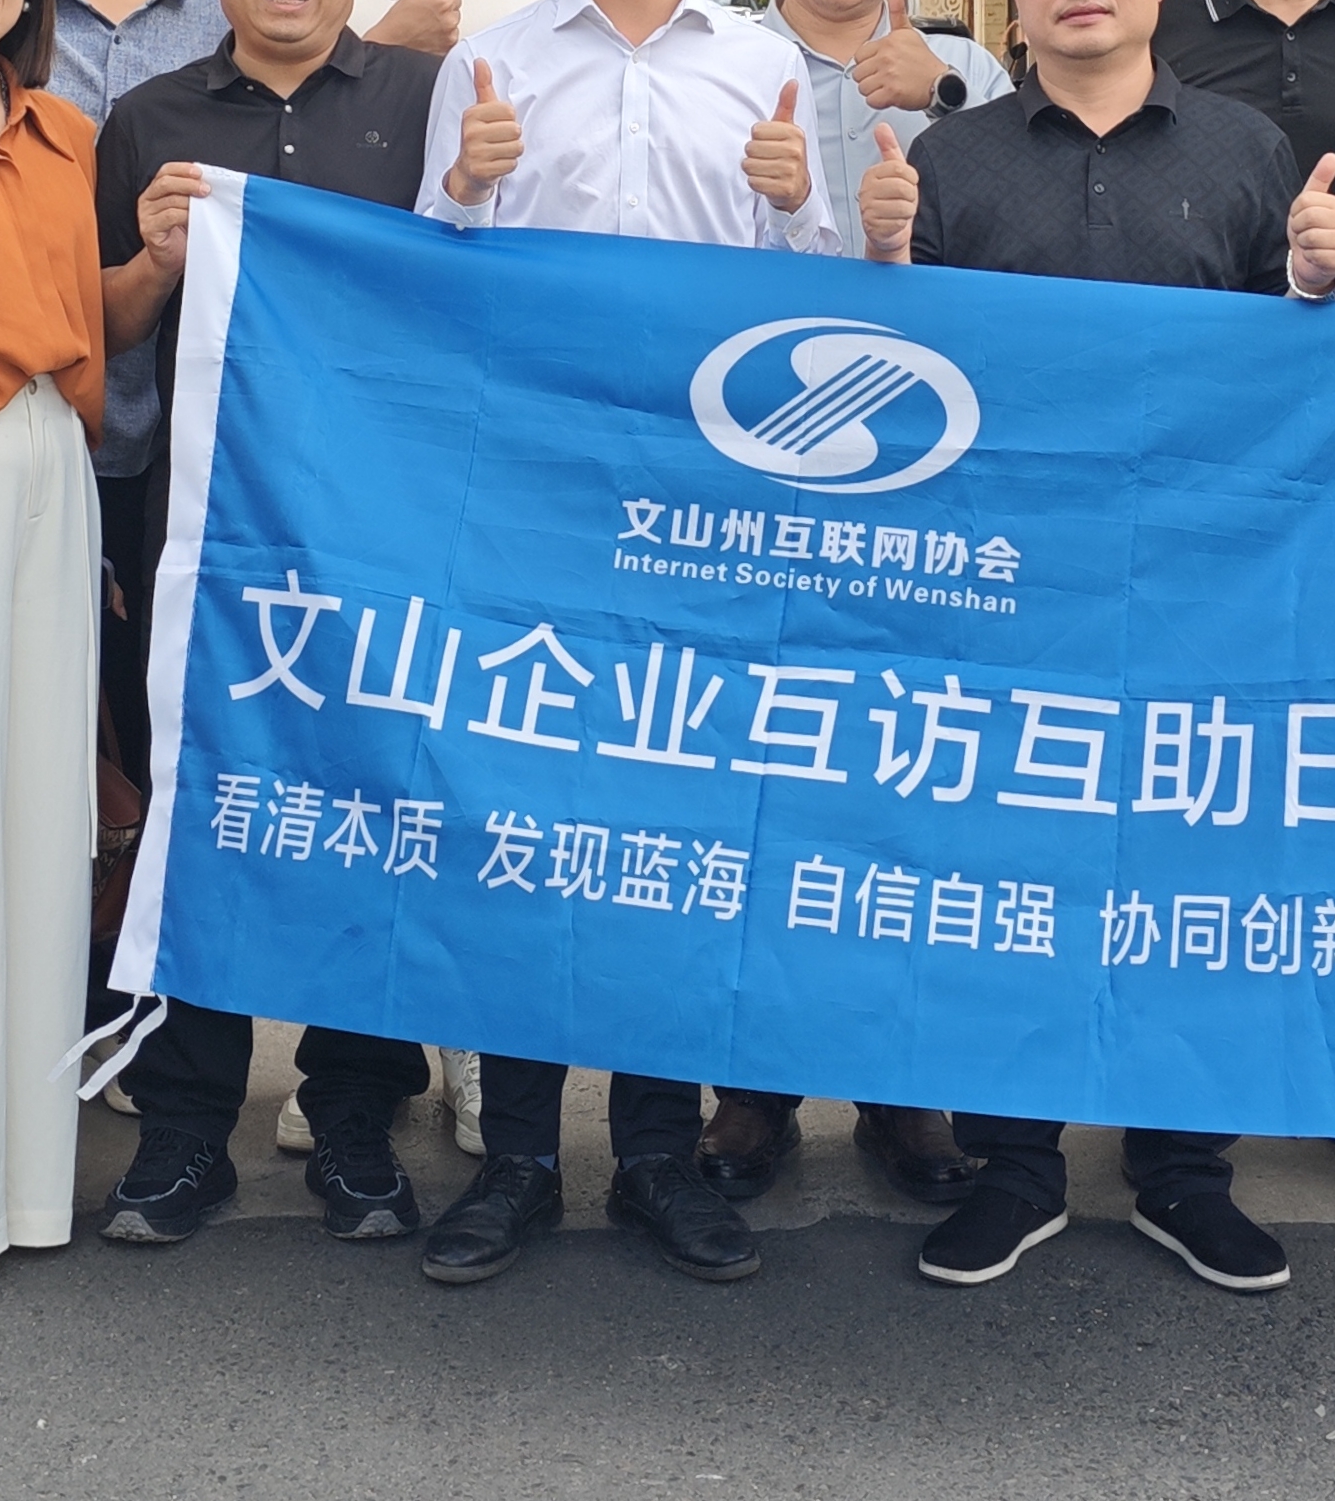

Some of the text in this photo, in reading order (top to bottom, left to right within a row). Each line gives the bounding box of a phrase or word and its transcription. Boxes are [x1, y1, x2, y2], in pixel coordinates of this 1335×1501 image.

[613, 548, 1016, 614] Internet Society of Wenshan
[617, 498, 1021, 584] 文山州互联网协会
[211, 774, 444, 880] 看清本质
[477, 810, 750, 921] 发现蓝海
[787, 854, 1055, 959] 自信自强
